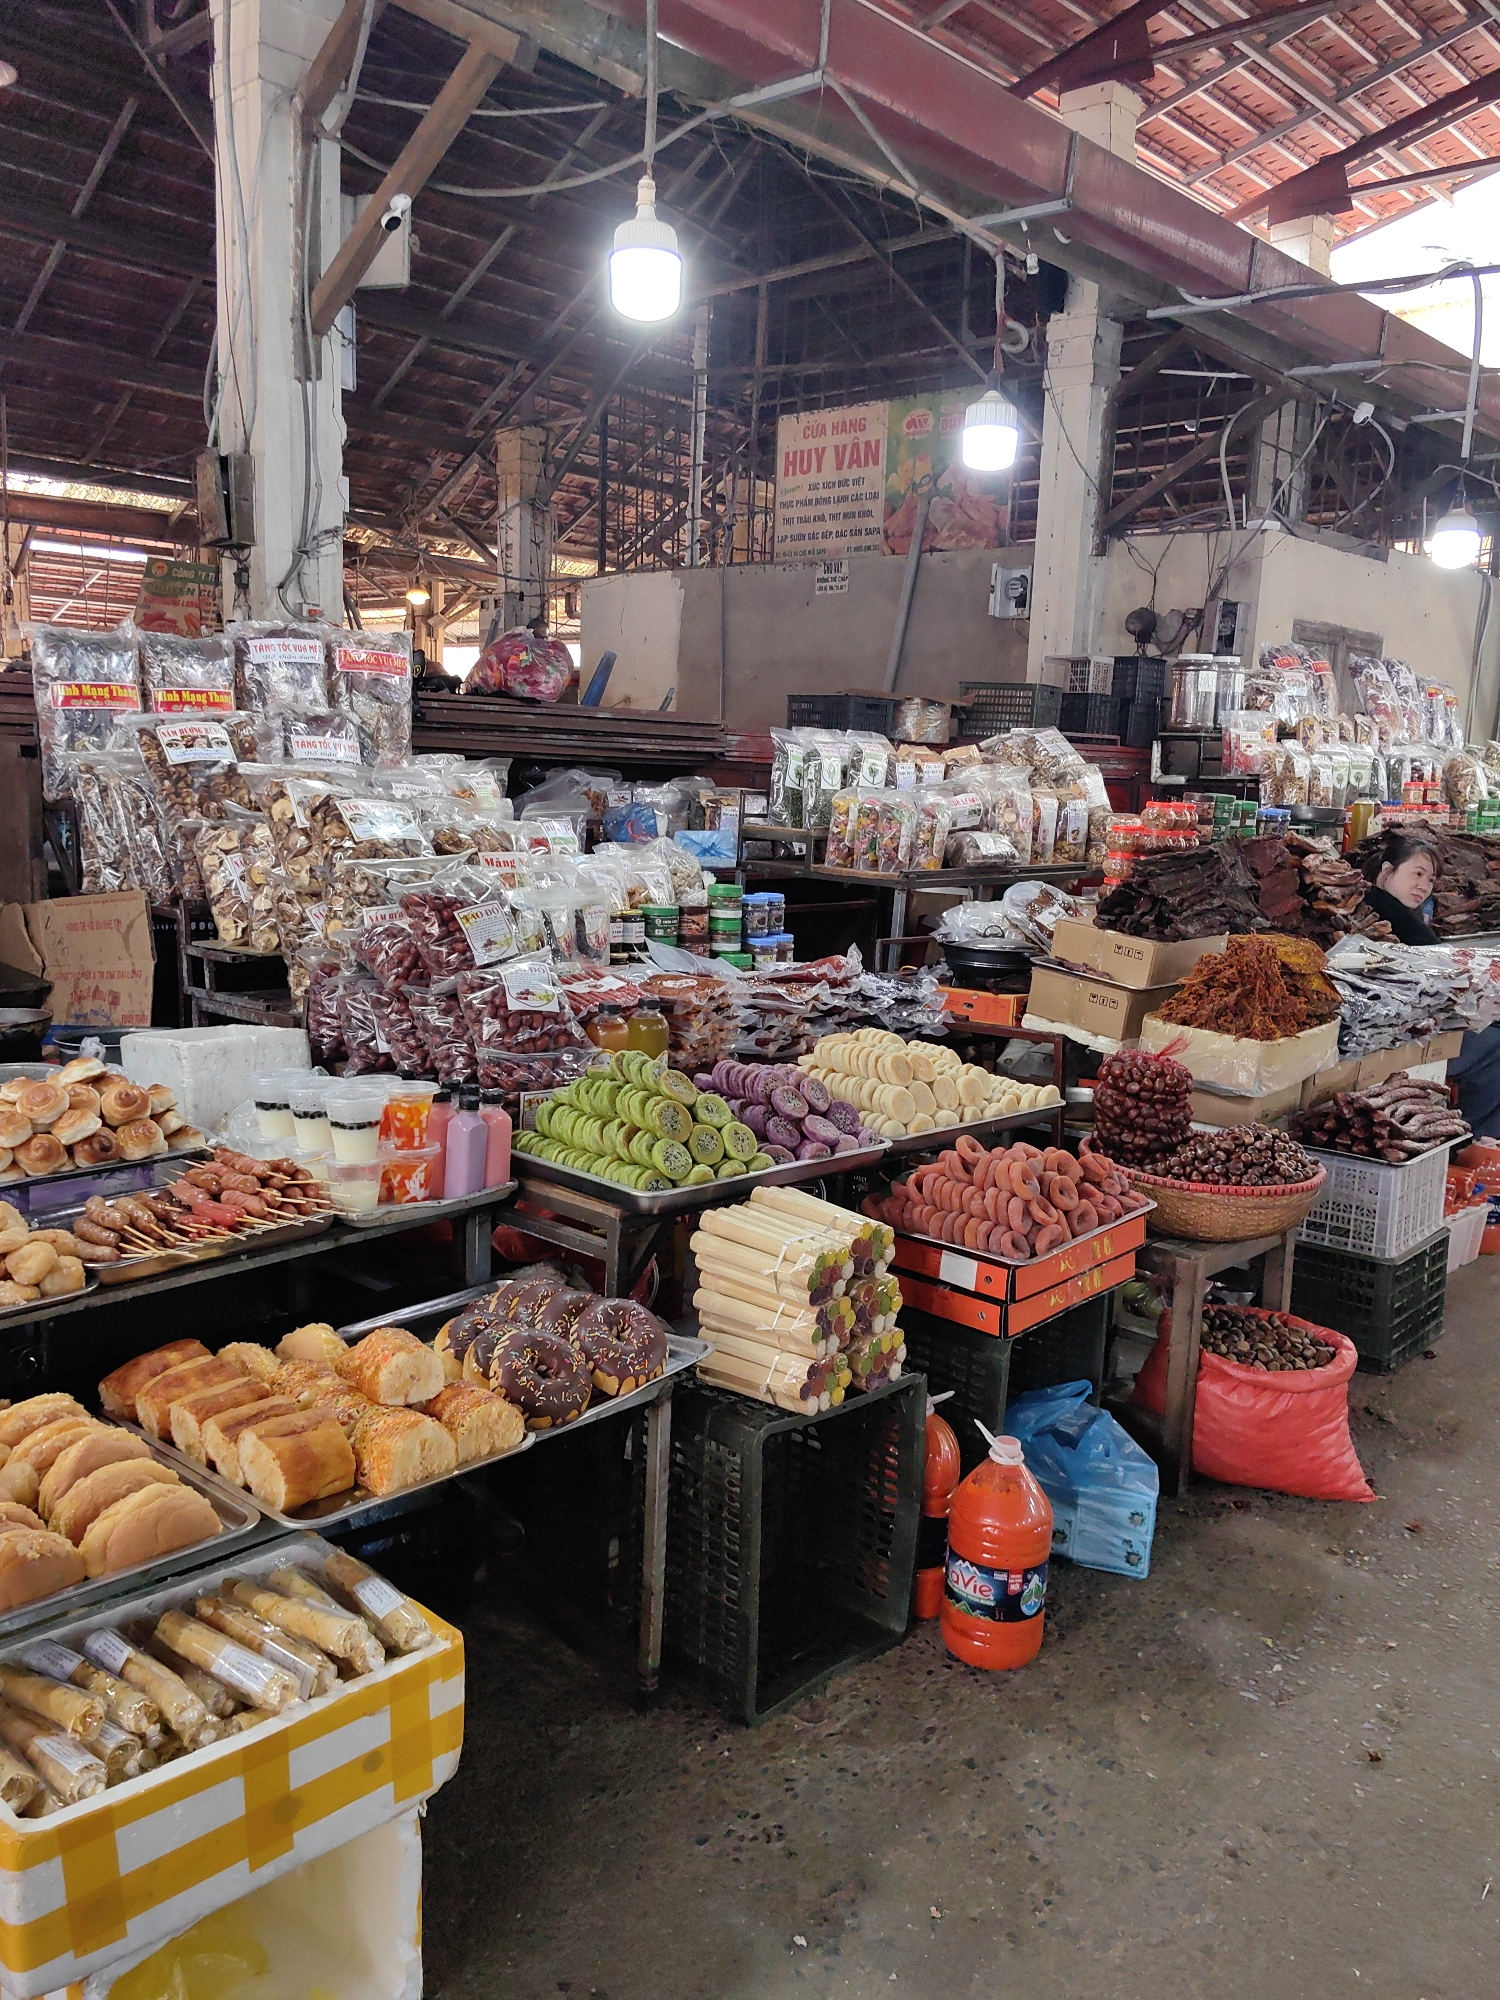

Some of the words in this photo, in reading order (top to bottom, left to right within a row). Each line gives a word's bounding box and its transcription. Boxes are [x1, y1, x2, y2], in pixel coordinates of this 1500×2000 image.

[803, 420, 827, 440] CỬA
[831, 416, 867, 436] HÀNG
[784, 446, 827, 477] HUY
[834, 436, 880, 471] VÂN
[808, 480, 820, 491] XÚC
[822, 479, 836, 490] XÍCH
[837, 477, 850, 489] ĐỨC
[851, 476, 865, 488] VIỆT
[851, 491, 864, 502] CÁC
[864, 526, 880, 536] SAPA
[171, 567, 195, 578] CÔNG
[81, 684, 110, 700] Mạng
[110, 684, 138, 701] Thang
[181, 690, 207, 706] Mạng
[207, 691, 232, 705] Thang
[179, 725, 203, 735] HƯƠNG
[484, 854, 516, 871] Măng
[949, 1567, 993, 1598] aVie
